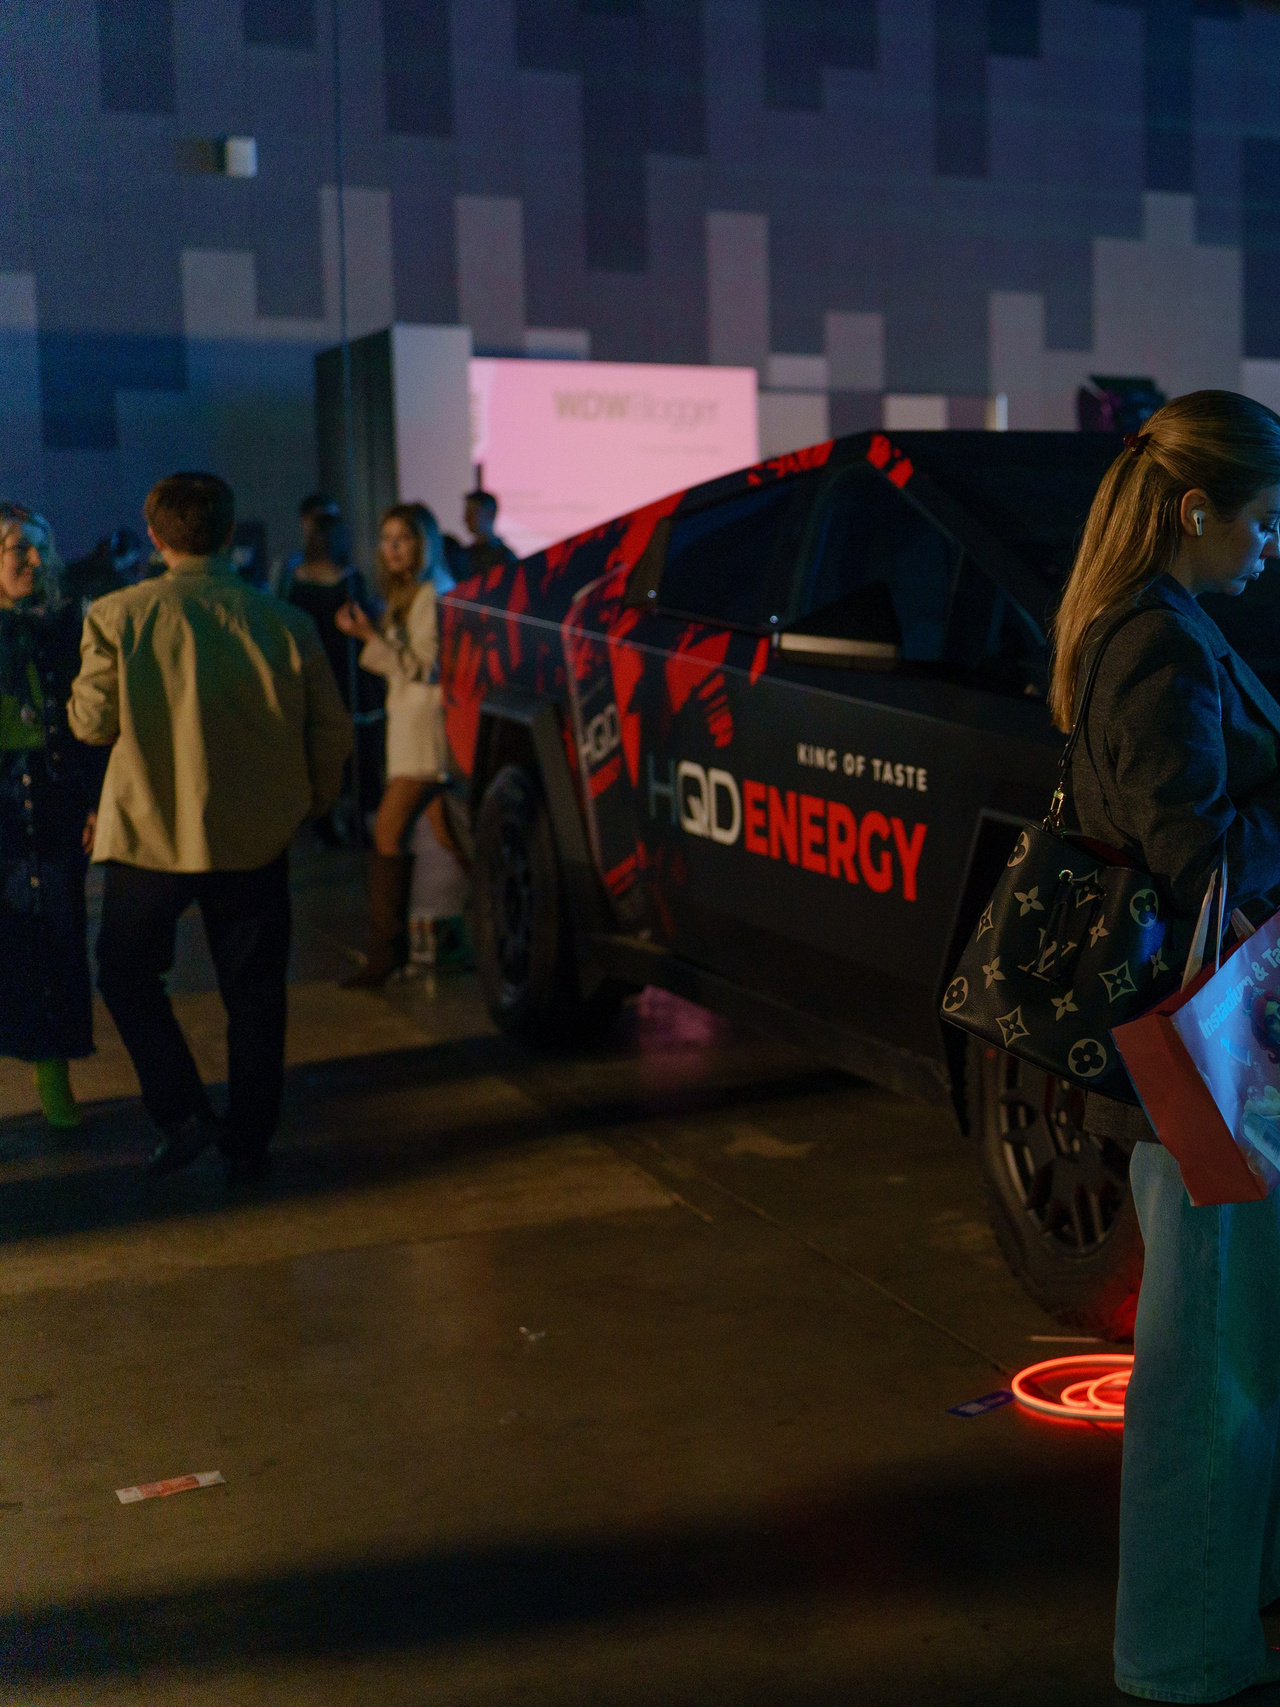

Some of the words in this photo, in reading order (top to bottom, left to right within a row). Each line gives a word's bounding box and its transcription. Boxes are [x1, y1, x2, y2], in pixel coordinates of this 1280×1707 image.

[797, 742, 837, 772] KING
[843, 752, 866, 777] OF
[871, 758, 928, 792] TASTE
[1251, 961, 1270, 982] &
